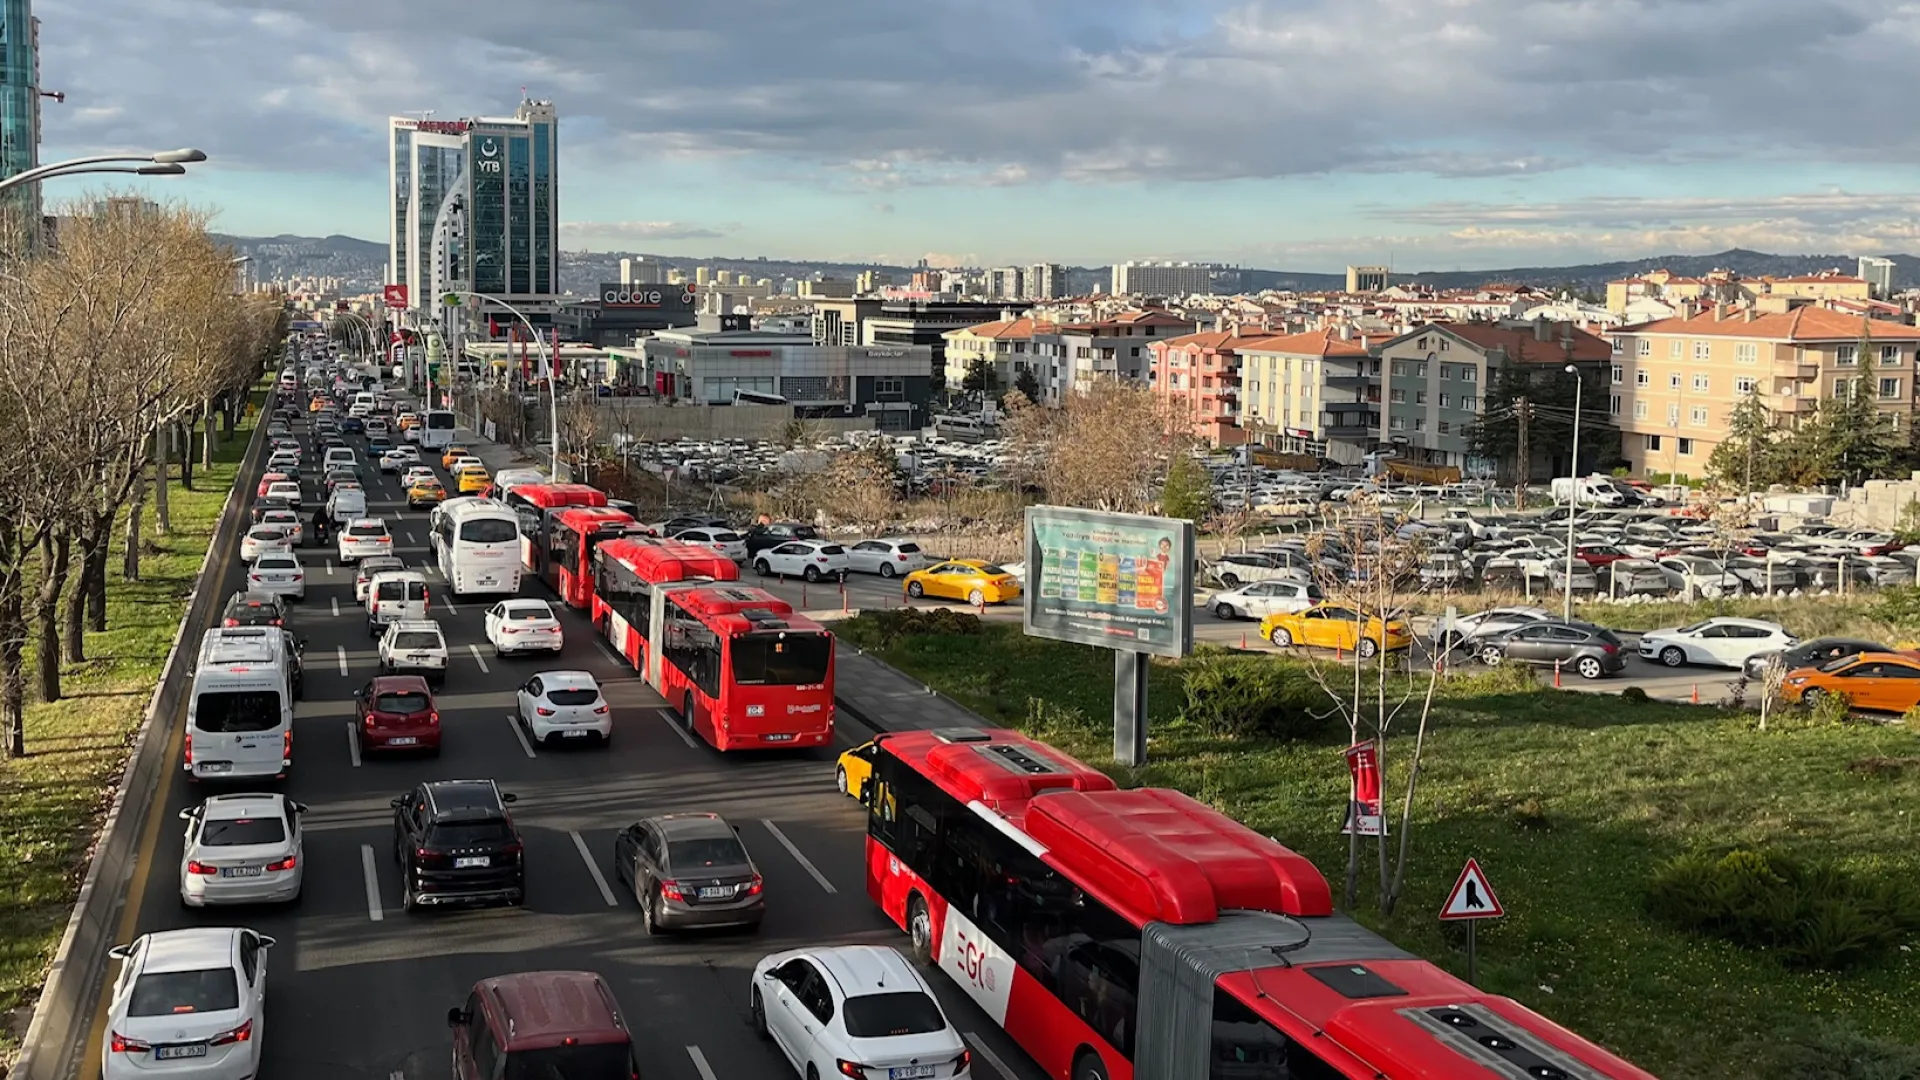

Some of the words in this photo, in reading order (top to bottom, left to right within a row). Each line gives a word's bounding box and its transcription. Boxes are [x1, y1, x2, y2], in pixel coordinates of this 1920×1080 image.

[477, 160, 500, 173] YTB
[454, 282, 466, 292] bp
[604, 286, 662, 304] adore
